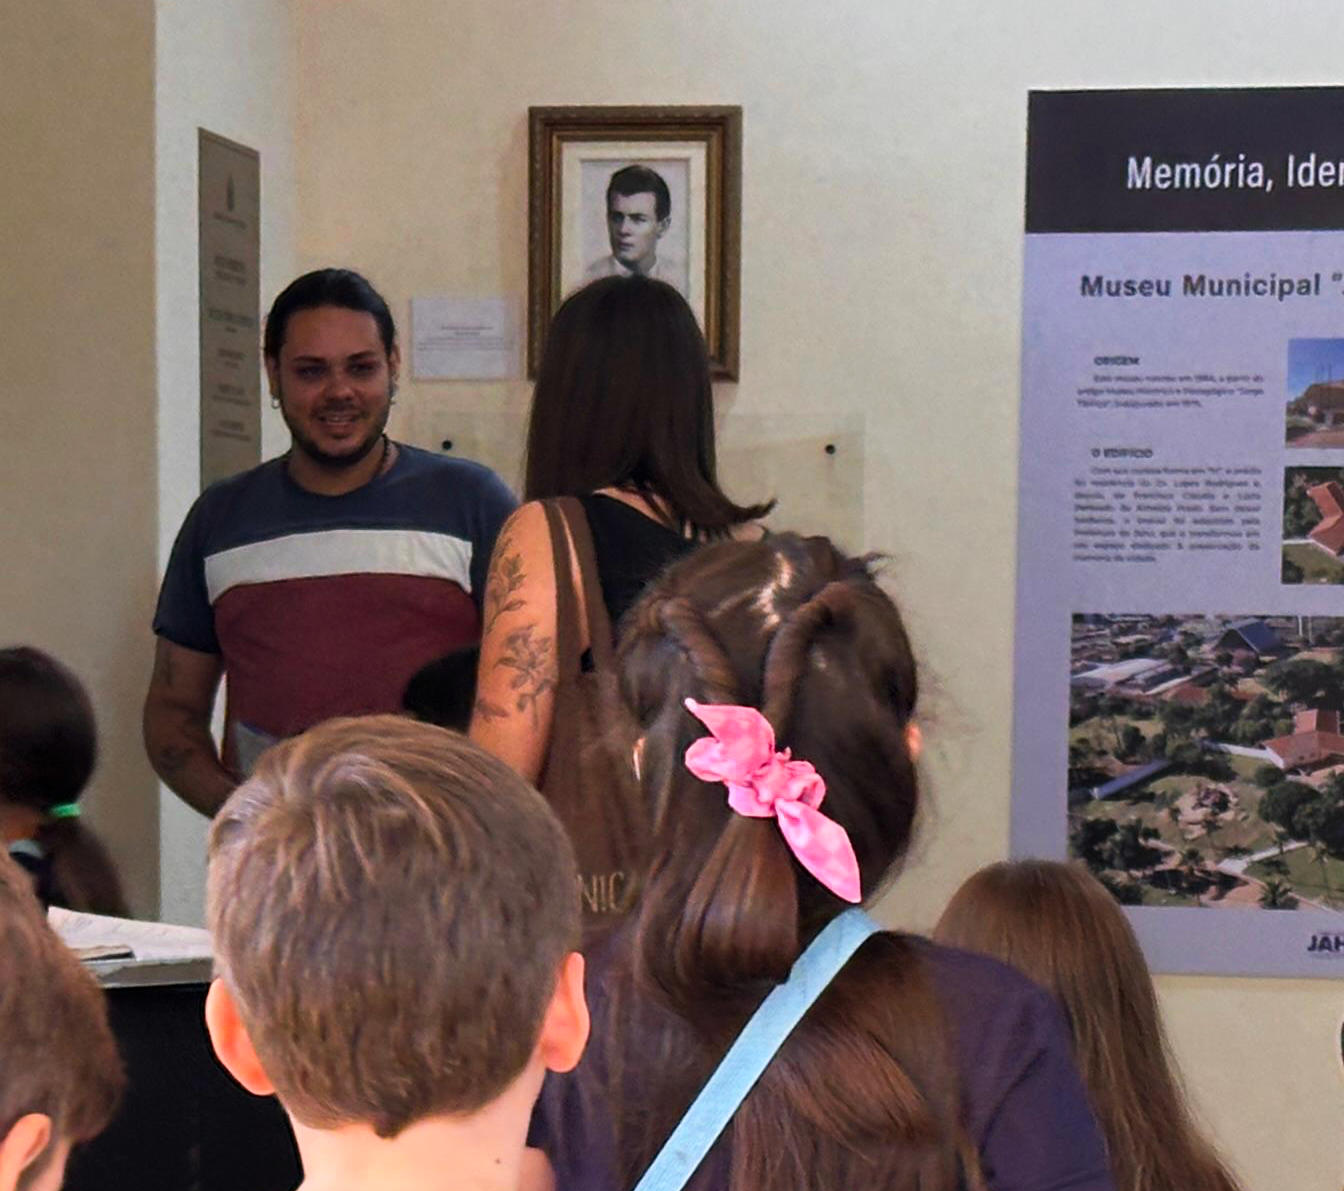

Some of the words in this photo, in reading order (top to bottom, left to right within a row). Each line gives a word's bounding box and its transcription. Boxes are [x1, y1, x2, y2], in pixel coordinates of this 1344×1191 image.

[1126, 154, 1273, 193] Memória,
[1081, 273, 1172, 298] Museu
[1182, 272, 1321, 301] Municipal
